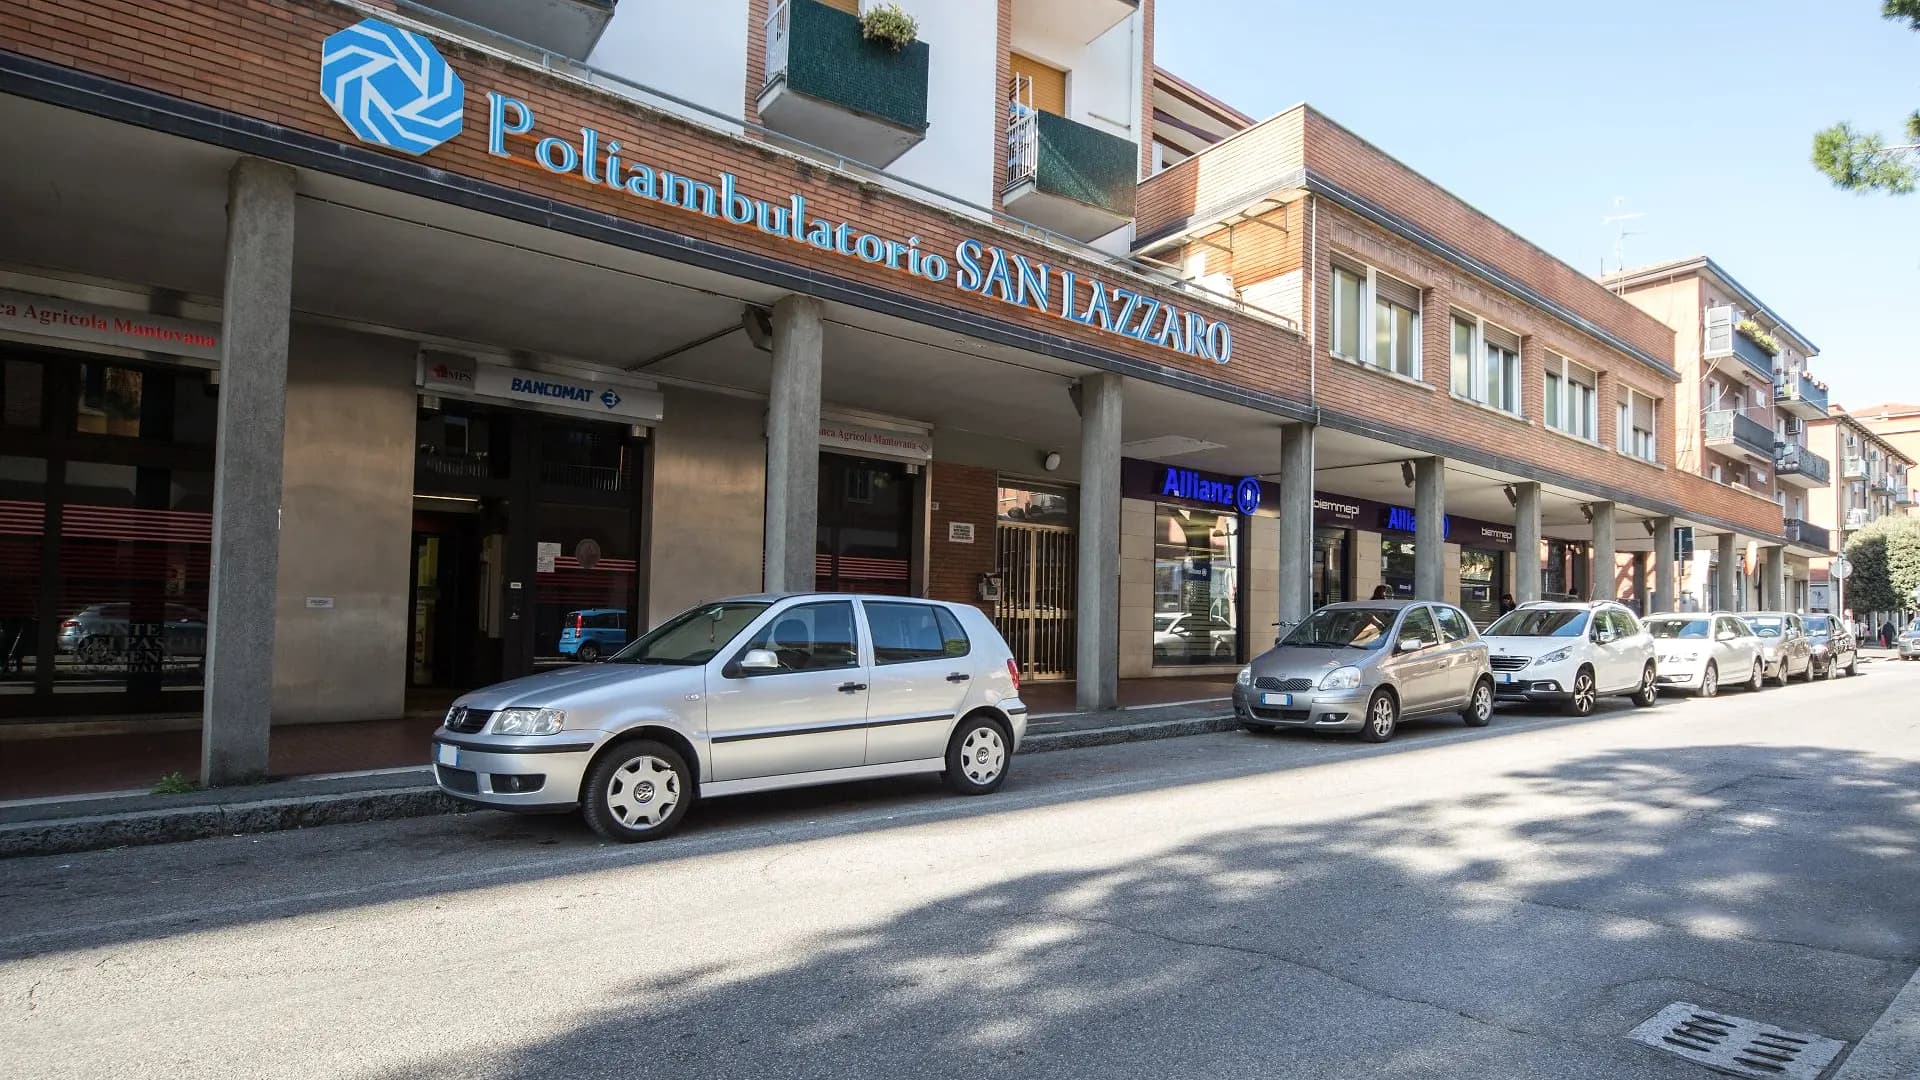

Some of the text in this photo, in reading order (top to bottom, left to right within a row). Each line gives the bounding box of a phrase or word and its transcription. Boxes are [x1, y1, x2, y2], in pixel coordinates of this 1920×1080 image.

[487, 91, 1233, 365] Poliambulatorio SAN LAZZARO
[23, 303, 108, 331] Agricola
[114, 318, 216, 348] Mantovana
[511, 377, 594, 402] BANCOMAT
[838, 429, 872, 443] Agricola
[873, 433, 917, 450] Mantovana
[1162, 467, 1234, 505] Allianz
